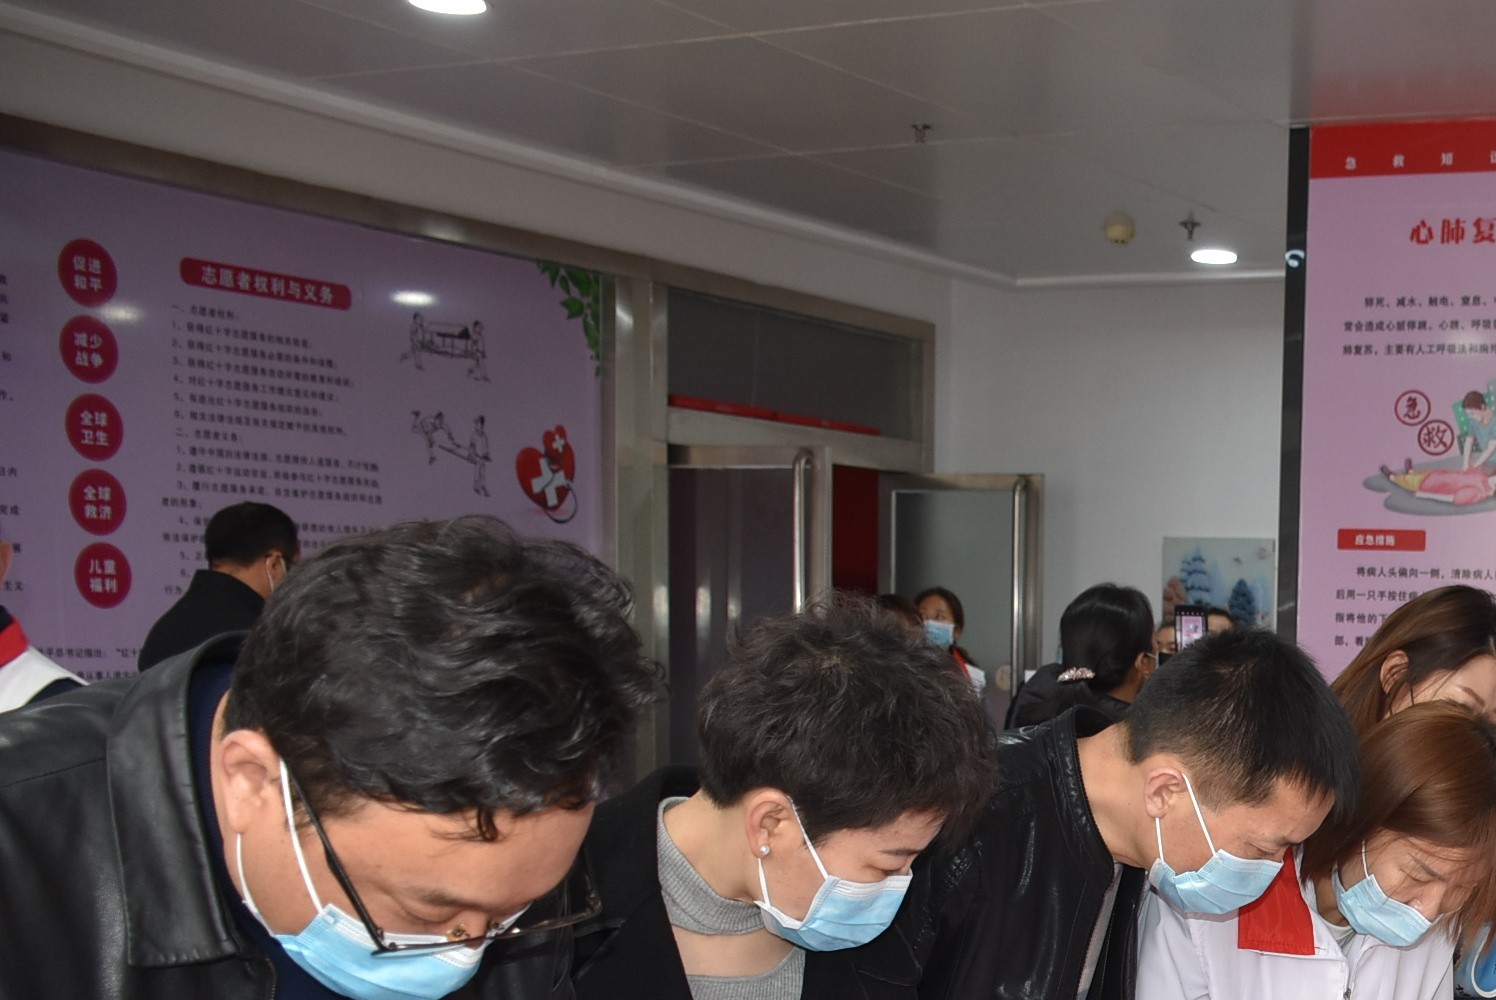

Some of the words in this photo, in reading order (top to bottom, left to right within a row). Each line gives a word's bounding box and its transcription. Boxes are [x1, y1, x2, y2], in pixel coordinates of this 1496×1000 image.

[73, 254, 102, 275] 促进
[73, 273, 103, 292] 和平
[201, 263, 335, 305] 志愿者权利与义务
[74, 331, 104, 350] 减少
[80, 410, 109, 428] 全球
[81, 429, 109, 447] 卫生
[1422, 426, 1449, 451] 救
[83, 485, 113, 502] 全球
[84, 504, 113, 521] 救济
[1354, 534, 1396, 547] 应急措施
[89, 559, 118, 576] 儿童
[89, 577, 118, 594] 福利
